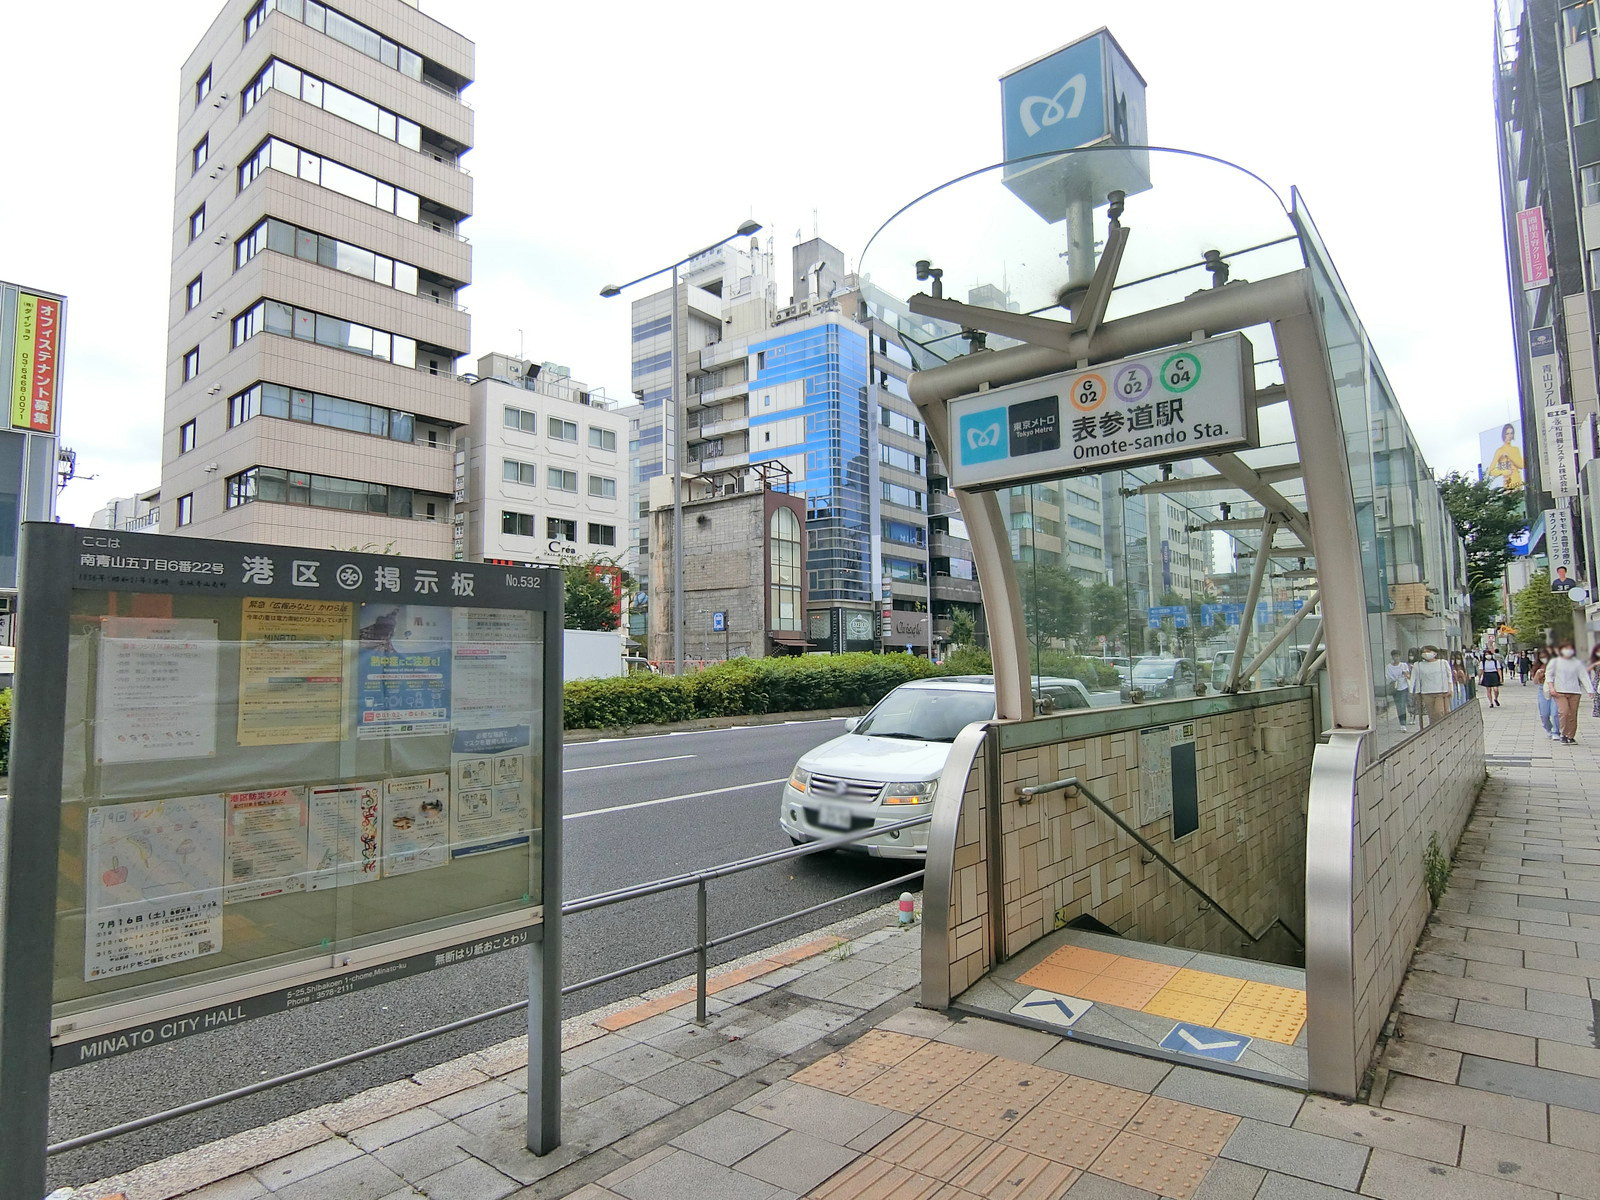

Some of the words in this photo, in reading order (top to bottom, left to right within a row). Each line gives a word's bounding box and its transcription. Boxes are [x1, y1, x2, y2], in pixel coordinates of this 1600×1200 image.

[33, 304, 55, 425] オフィステナント募集
[1174, 359, 1184, 371] C
[1127, 369, 1137, 381] Z
[1170, 370, 1191, 385] 04
[1082, 380, 1093, 391] G
[1123, 381, 1142, 395] 02
[1079, 391, 1097, 404] 02
[1013, 415, 1055, 432] 東京メトロ
[1071, 397, 1185, 443] 表参道駅
[1016, 430, 1034, 438] Tokyo
[1034, 426, 1053, 435] Metro
[1073, 427, 1187, 460] Omote-sando
[1193, 423, 1229, 440] Sta.
[82, 536, 121, 549] ここは
[1549, 512, 1560, 560] オクノクリニック
[80, 553, 225, 575] 南青山五丁目6番22号
[505, 573, 541, 589] No.532
[435, 932, 528, 966] 無断はり紙おことわり
[316, 983, 354, 999] 3578-2111
[80, 1028, 154, 1060] MINATO
[160, 1017, 199, 1039] CITY
[205, 1005, 247, 1027] HALL
